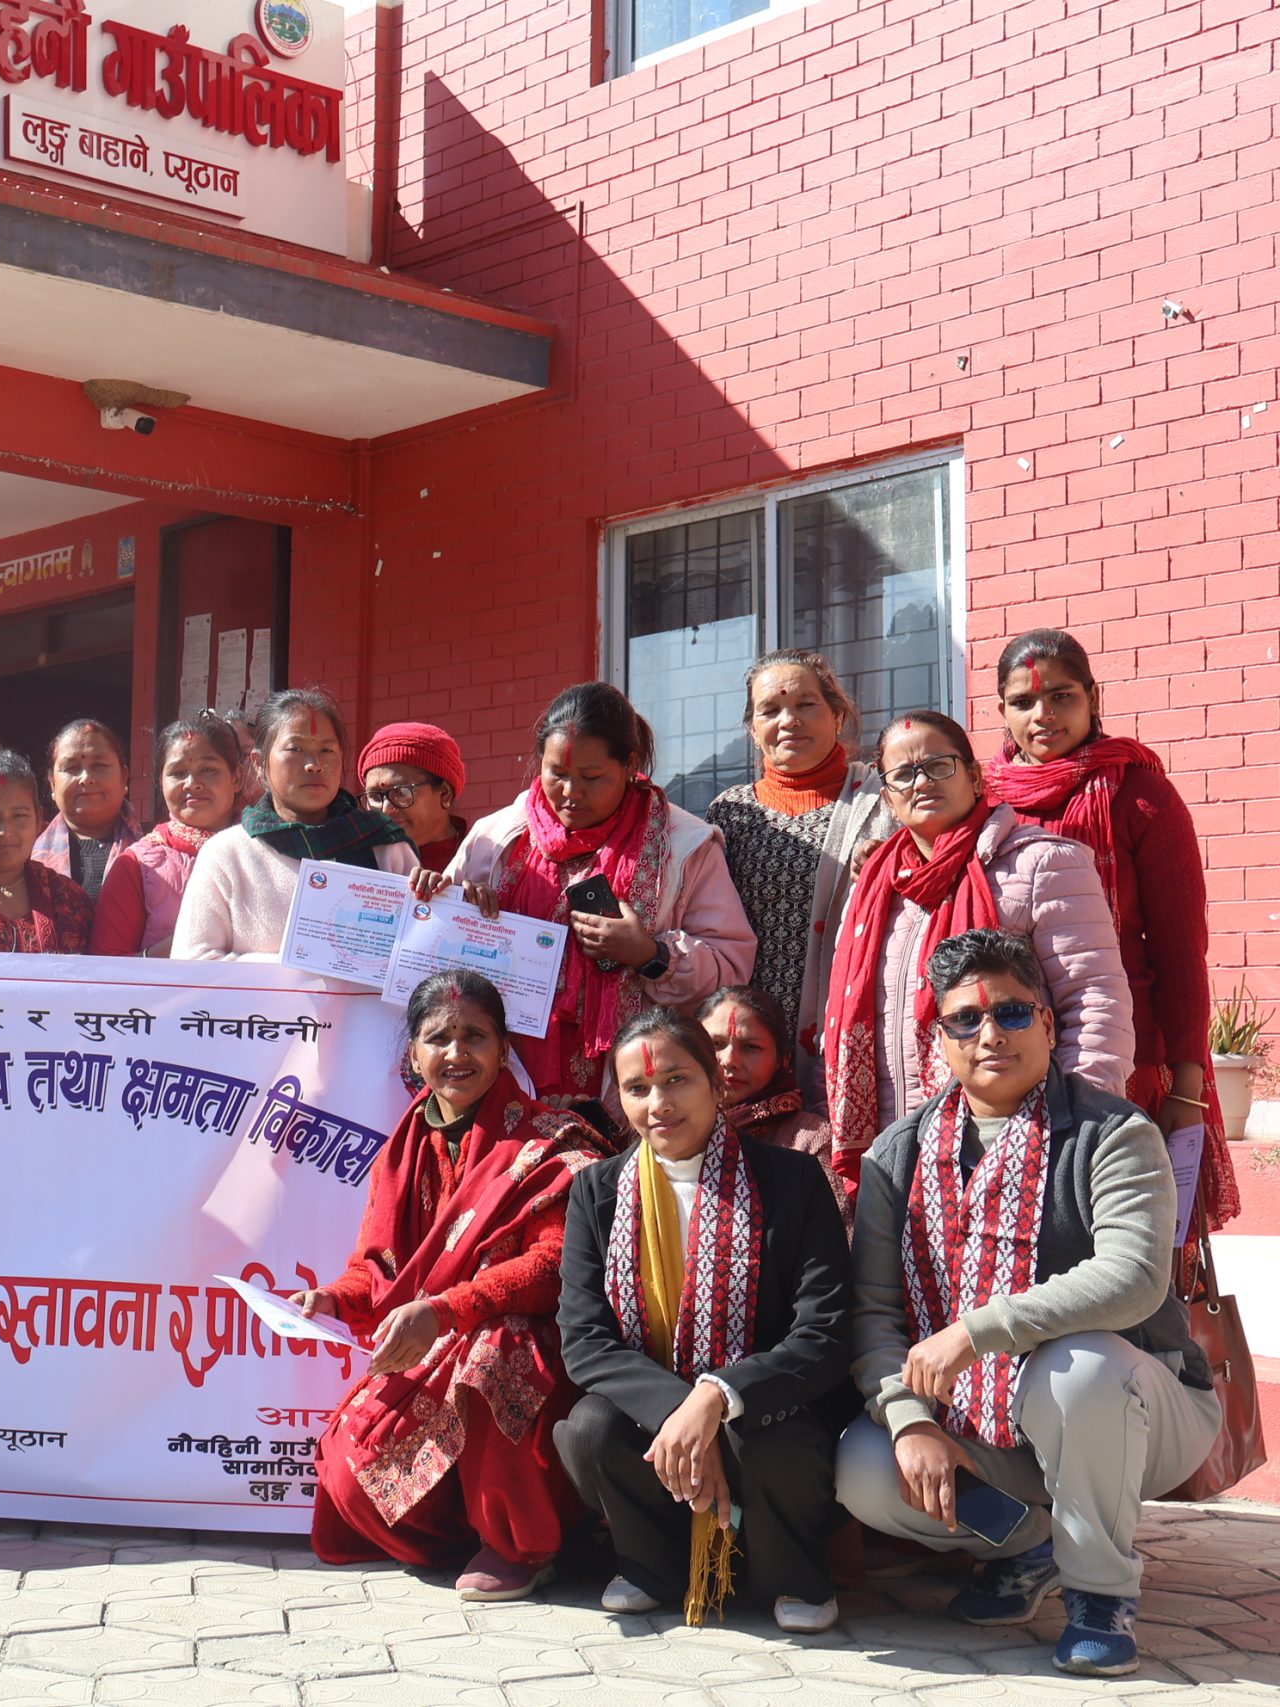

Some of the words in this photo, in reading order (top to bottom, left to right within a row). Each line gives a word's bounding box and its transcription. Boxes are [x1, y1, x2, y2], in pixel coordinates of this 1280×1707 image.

[163, 150, 240, 197] प्यूठान
[27, 1010, 50, 1031] र
[74, 1008, 157, 1042] सुखी
[24, 1050, 114, 1111] तथा
[121, 1055, 259, 1136] क्षमता
[248, 1074, 387, 1186] विकास
[167, 1432, 262, 1458] नौबहिनी
